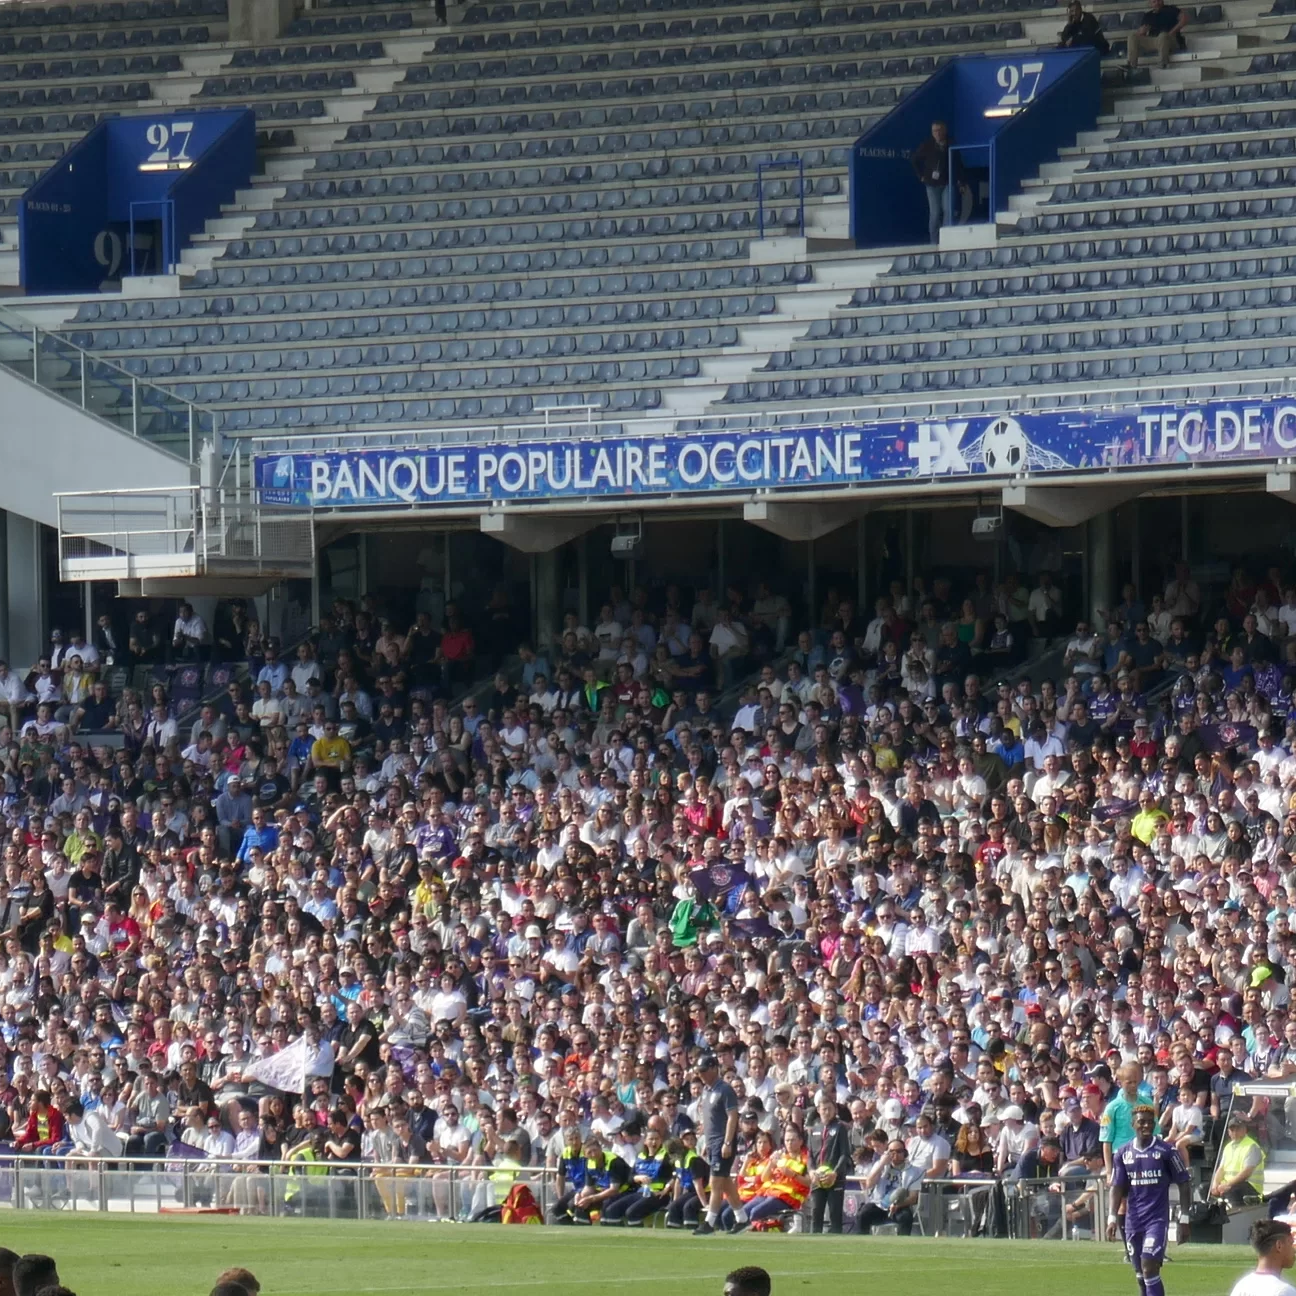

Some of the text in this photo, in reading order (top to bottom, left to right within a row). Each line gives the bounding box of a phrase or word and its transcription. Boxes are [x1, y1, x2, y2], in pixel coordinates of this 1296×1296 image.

[996, 62, 1044, 106] 27
[146, 121, 194, 163] 27
[1137, 410, 1203, 457] TFC
[1216, 407, 1262, 453] DE
[313, 434, 861, 502] BANQUE POPULAIRE OCCITANE
